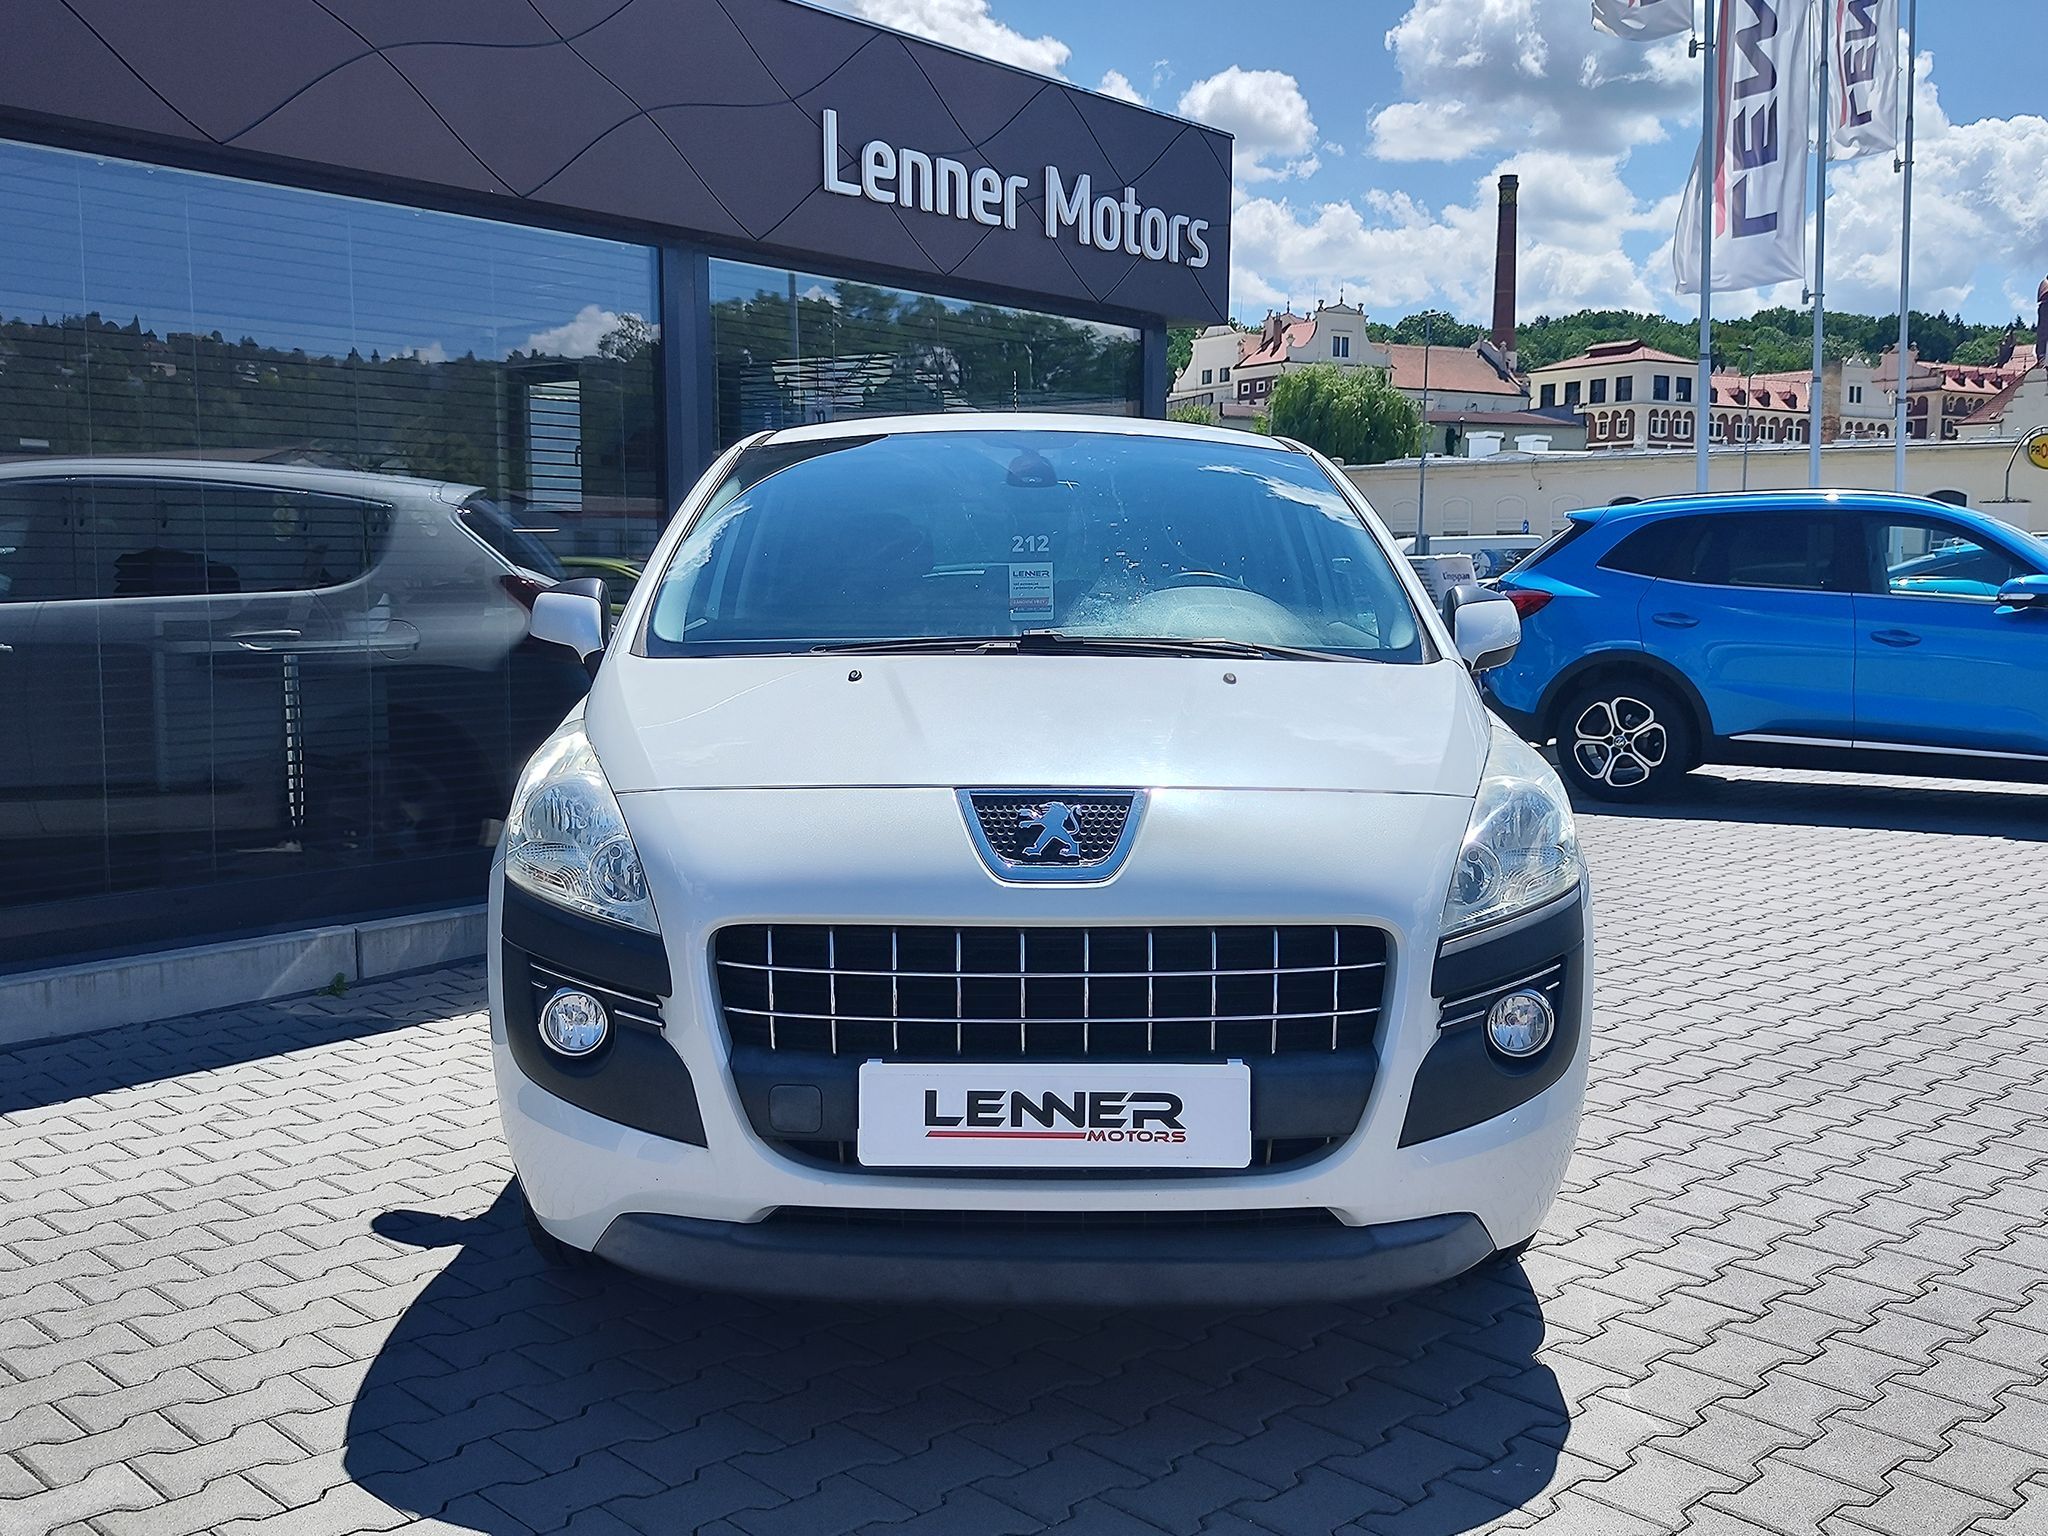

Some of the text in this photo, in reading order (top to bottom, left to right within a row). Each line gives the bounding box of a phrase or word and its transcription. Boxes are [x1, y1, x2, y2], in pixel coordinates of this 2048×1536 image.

[822, 108, 1210, 269] Lenner Motors
[1011, 535, 1050, 552] 212
[924, 1090, 1186, 1128] LENNER
[1086, 1131, 1186, 1143] MOTORS
